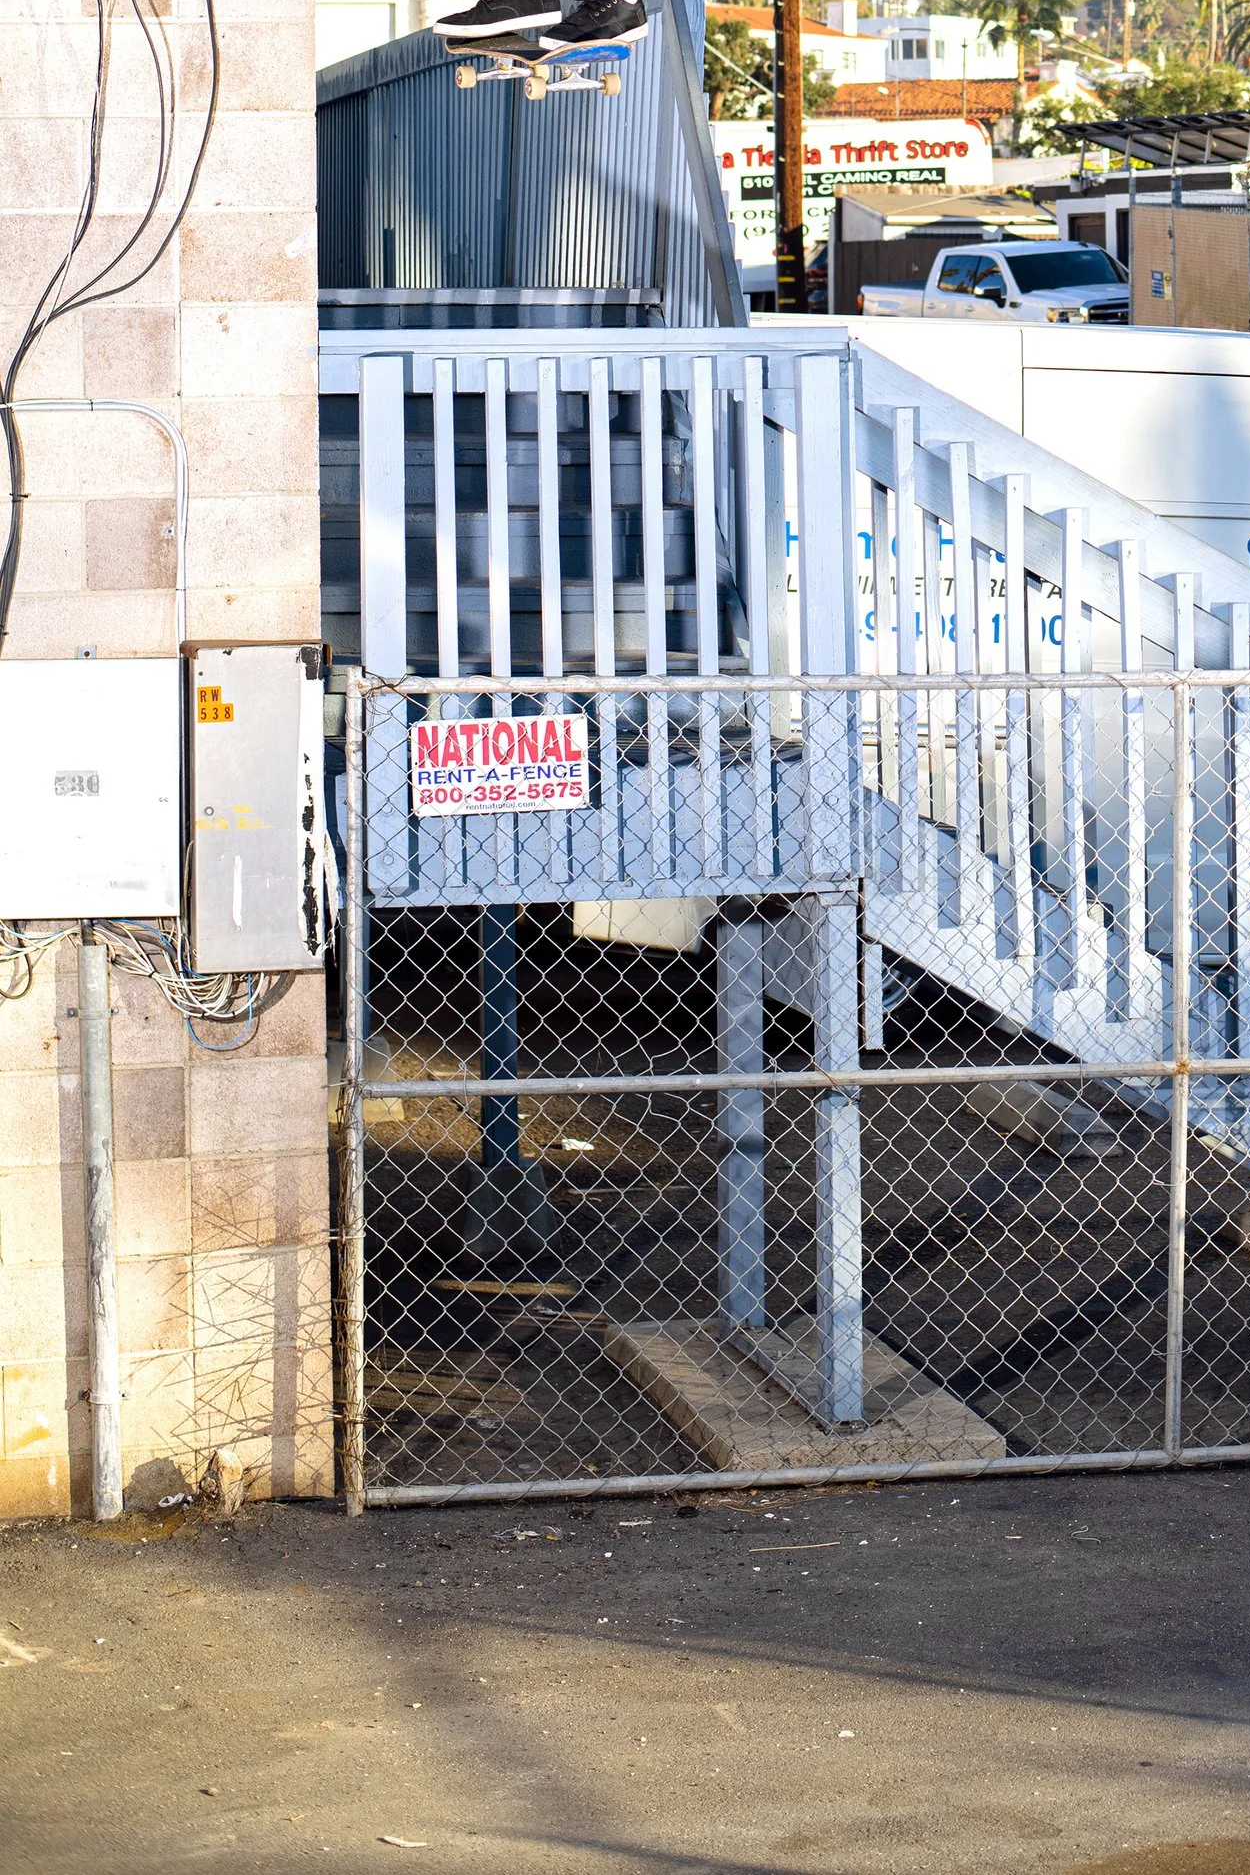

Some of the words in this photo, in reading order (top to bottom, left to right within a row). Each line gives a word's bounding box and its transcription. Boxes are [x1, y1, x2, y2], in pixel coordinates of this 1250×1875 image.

[721, 151, 735, 169] a
[741, 143, 822, 167] Tiea
[829, 140, 899, 164] Thrift
[905, 139, 969, 160] Store
[820, 170, 893, 185] CAMINO
[895, 168, 943, 182] REAL
[200, 706, 232, 721] 538
[417, 719, 583, 769] NATIONAL
[417, 763, 583, 786] RENT-A-FENCE
[419, 781, 584, 805] 800-352-5675
[465, 800, 537, 811] rentnational.com
